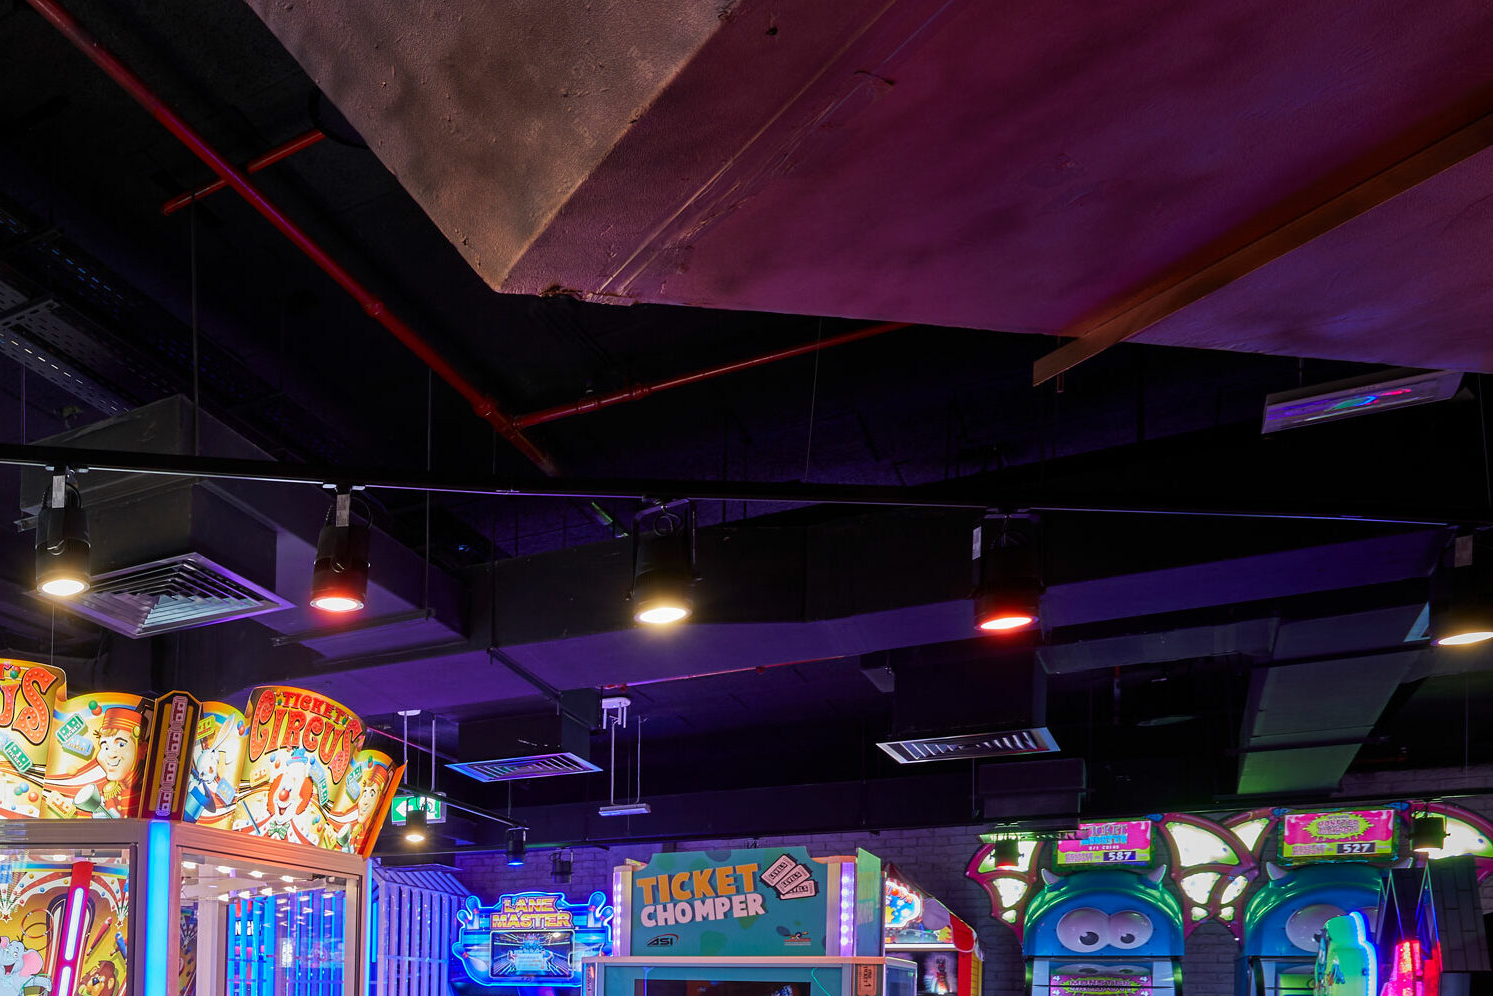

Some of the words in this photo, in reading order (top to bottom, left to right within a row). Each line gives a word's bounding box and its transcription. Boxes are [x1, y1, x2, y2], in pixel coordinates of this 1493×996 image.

[282, 690, 348, 725] TICKET
[248, 688, 363, 784] CIRCUS
[1108, 852, 1132, 861] 587
[1343, 844, 1371, 853] 527
[637, 863, 758, 905] TICKET
[503, 897, 556, 913] LANE
[640, 893, 766, 928] CHOMPER
[492, 913, 571, 928] MASTER
[646, 936, 675, 947] ASI
